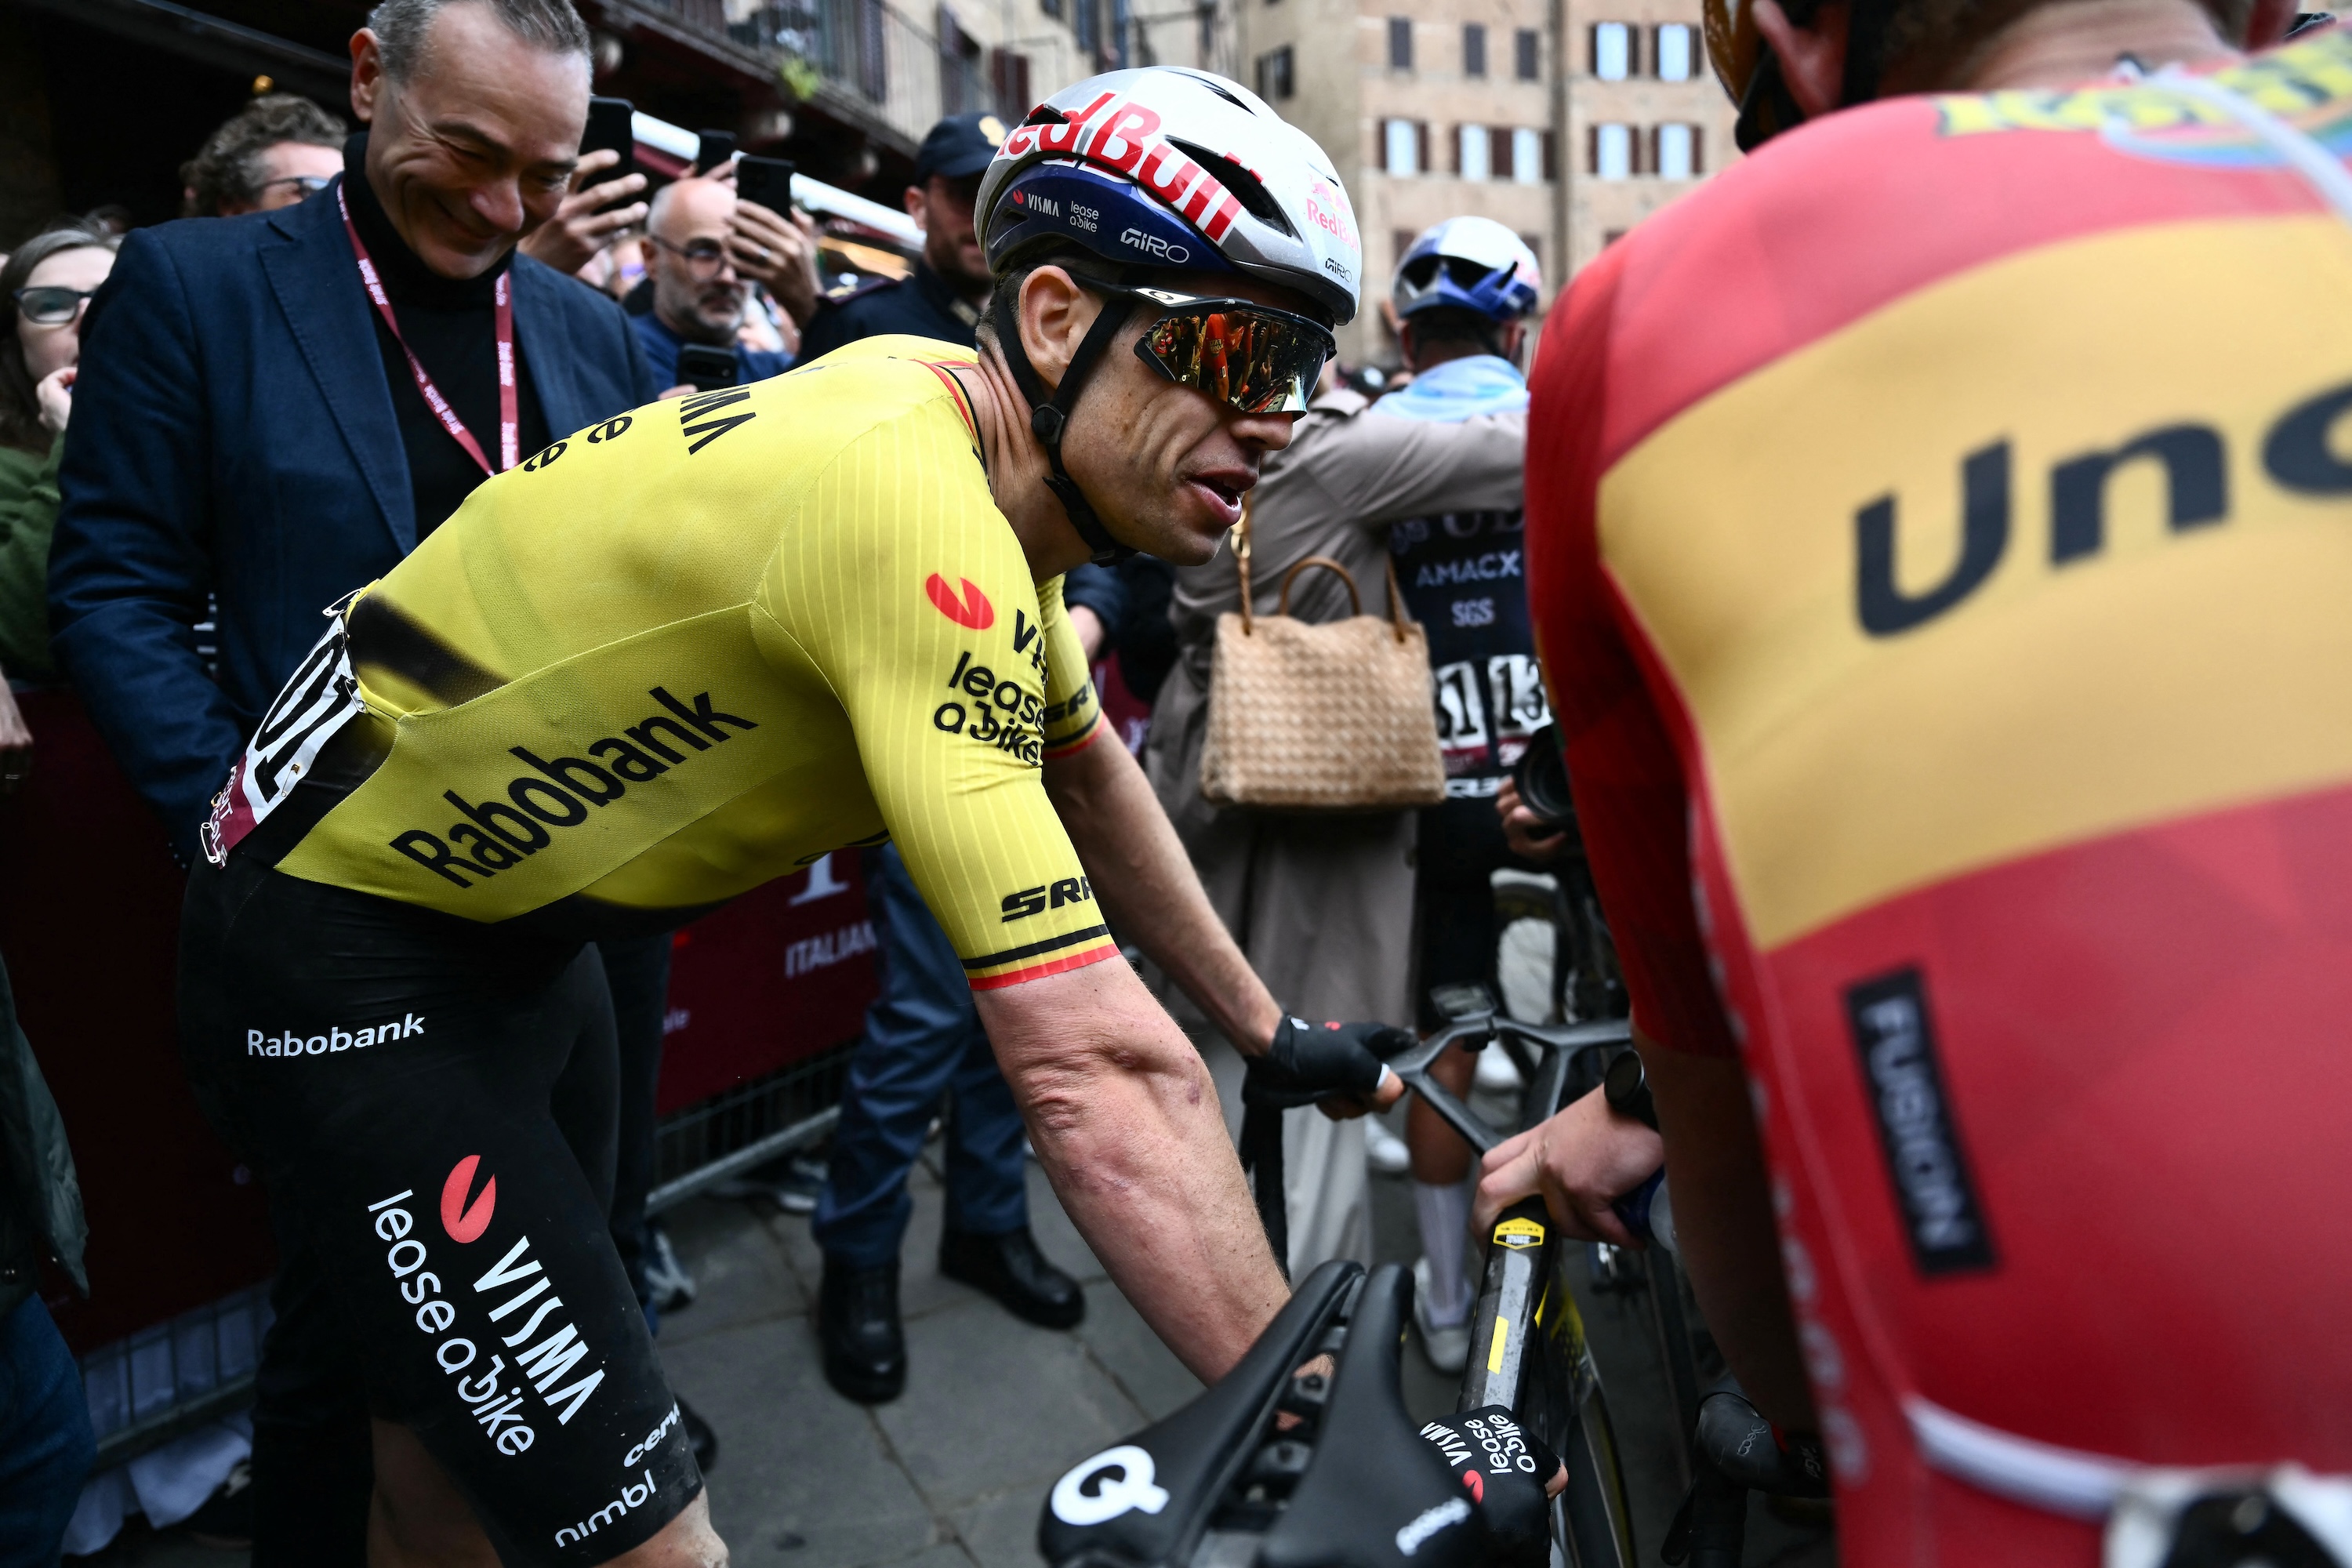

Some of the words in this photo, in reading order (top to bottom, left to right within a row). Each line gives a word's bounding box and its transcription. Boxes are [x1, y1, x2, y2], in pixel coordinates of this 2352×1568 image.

[1028, 193, 1060, 218] VISMA
[1070, 200, 1099, 221] lease
[1306, 198, 1338, 237] Red
[1120, 227, 1190, 263] GIRO
[1325, 257, 1352, 284] GIRO
[1417, 550, 1521, 586] AMACX
[1451, 597, 1495, 627] SGS
[948, 651, 1046, 735] lease
[388, 686, 760, 889] Rabobank
[247, 1012, 426, 1057] Rabobank
[1857, 994, 1980, 1249] FUSION
[368, 1189, 456, 1334] lease
[473, 1235, 605, 1425] VISMA
[1419, 1421, 1472, 1467] VISMA
[1464, 1419, 1513, 1475] lease
[554, 1469, 657, 1548] nimbl
